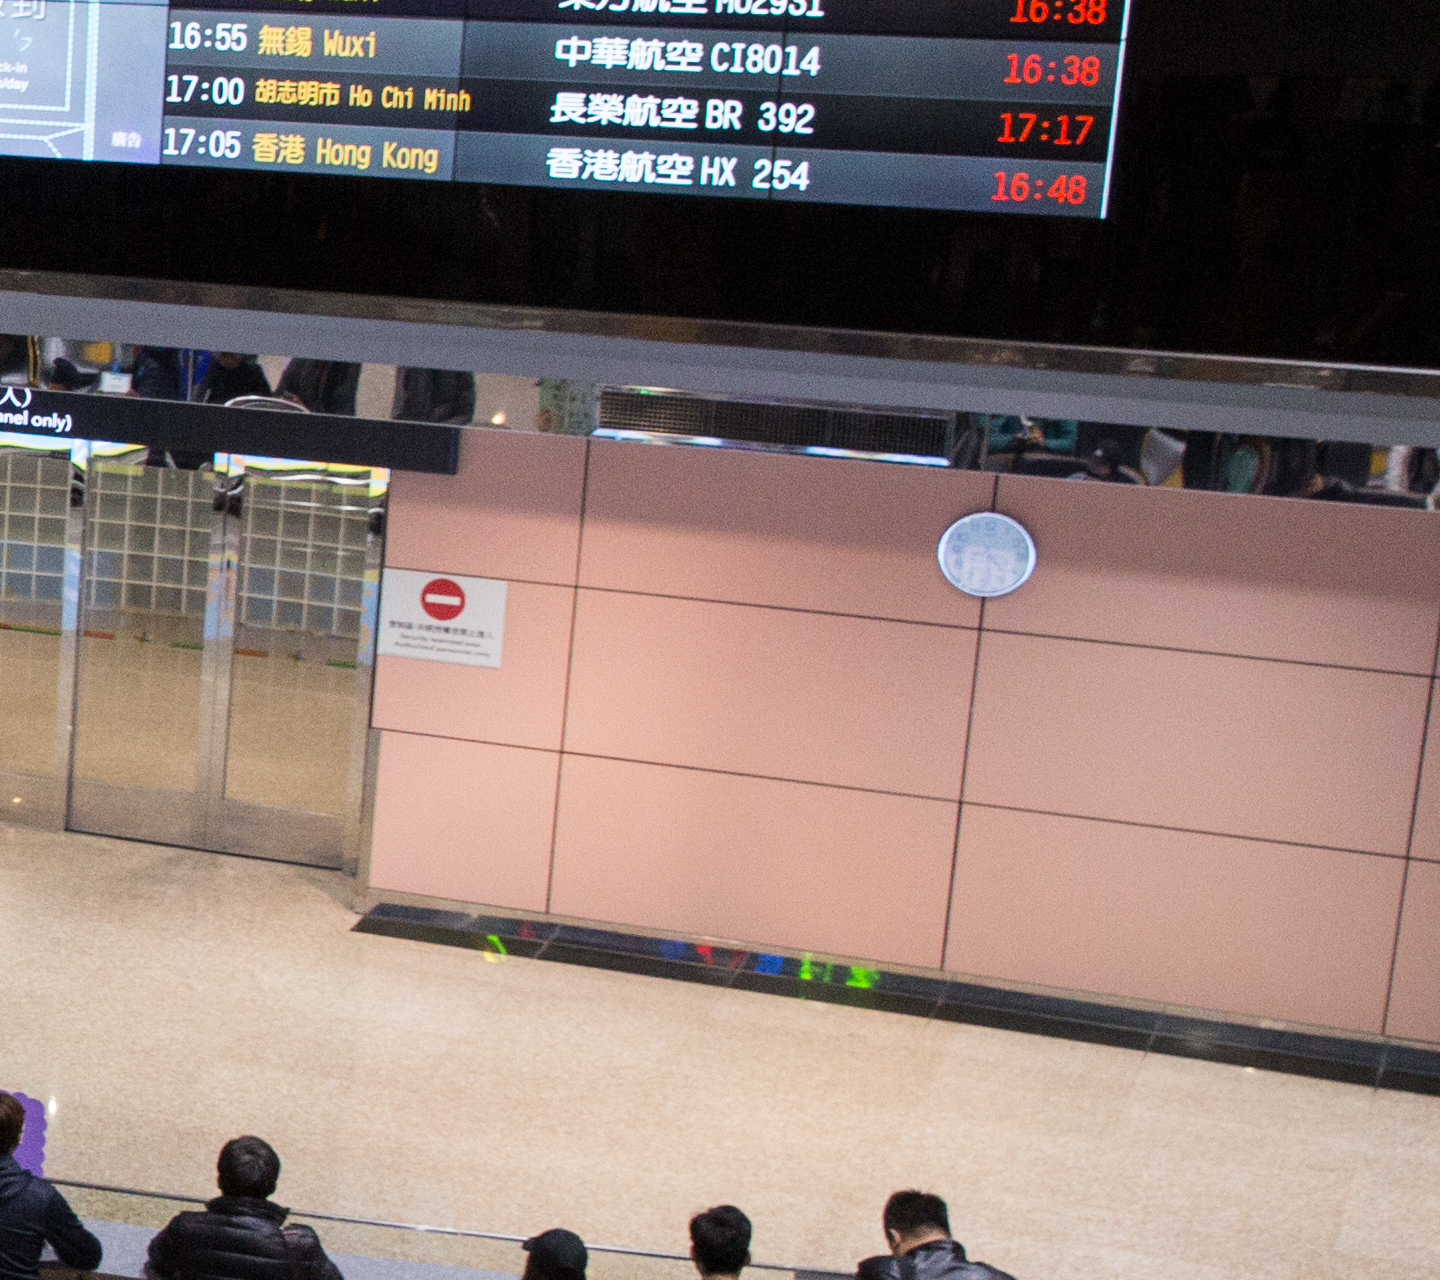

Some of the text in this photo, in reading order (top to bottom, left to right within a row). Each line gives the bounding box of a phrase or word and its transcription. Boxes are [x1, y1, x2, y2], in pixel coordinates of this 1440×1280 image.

[162, 127, 242, 159] 17:05
[253, 132, 305, 164] 香港
[316, 137, 372, 170] Hong
[382, 141, 439, 174] Kong
[546, 147, 695, 185] 香港航空
[700, 155, 738, 187] HX
[752, 158, 811, 191] 254
[991, 171, 1087, 205] 16:48
[32, 414, 72, 431] only)
